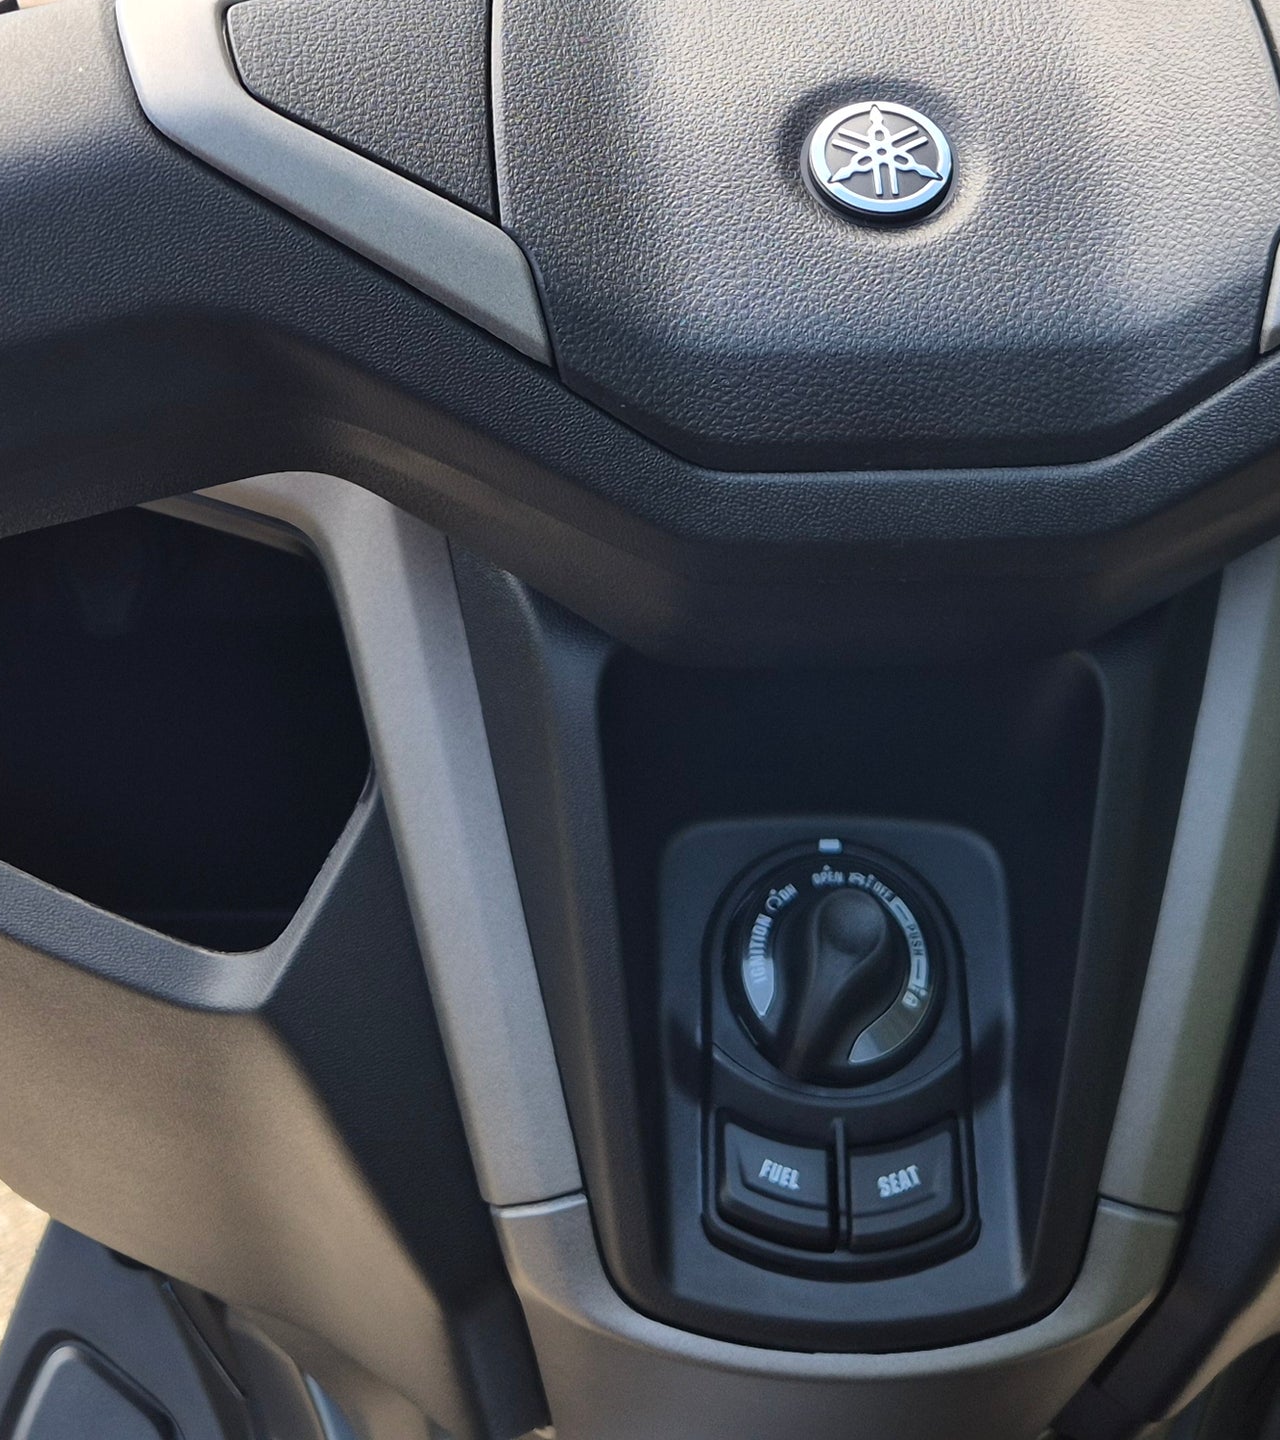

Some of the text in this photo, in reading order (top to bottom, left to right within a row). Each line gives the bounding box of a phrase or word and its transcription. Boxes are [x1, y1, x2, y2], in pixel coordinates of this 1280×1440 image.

[778, 882, 799, 903] ON
[812, 871, 845, 887] OPEN
[871, 880, 896, 902] OFF
[748, 912, 773, 984] IGNITION
[905, 923, 925, 957] PUSH
[758, 1158, 801, 1191] FUEL
[877, 1164, 921, 1198] SEAT
